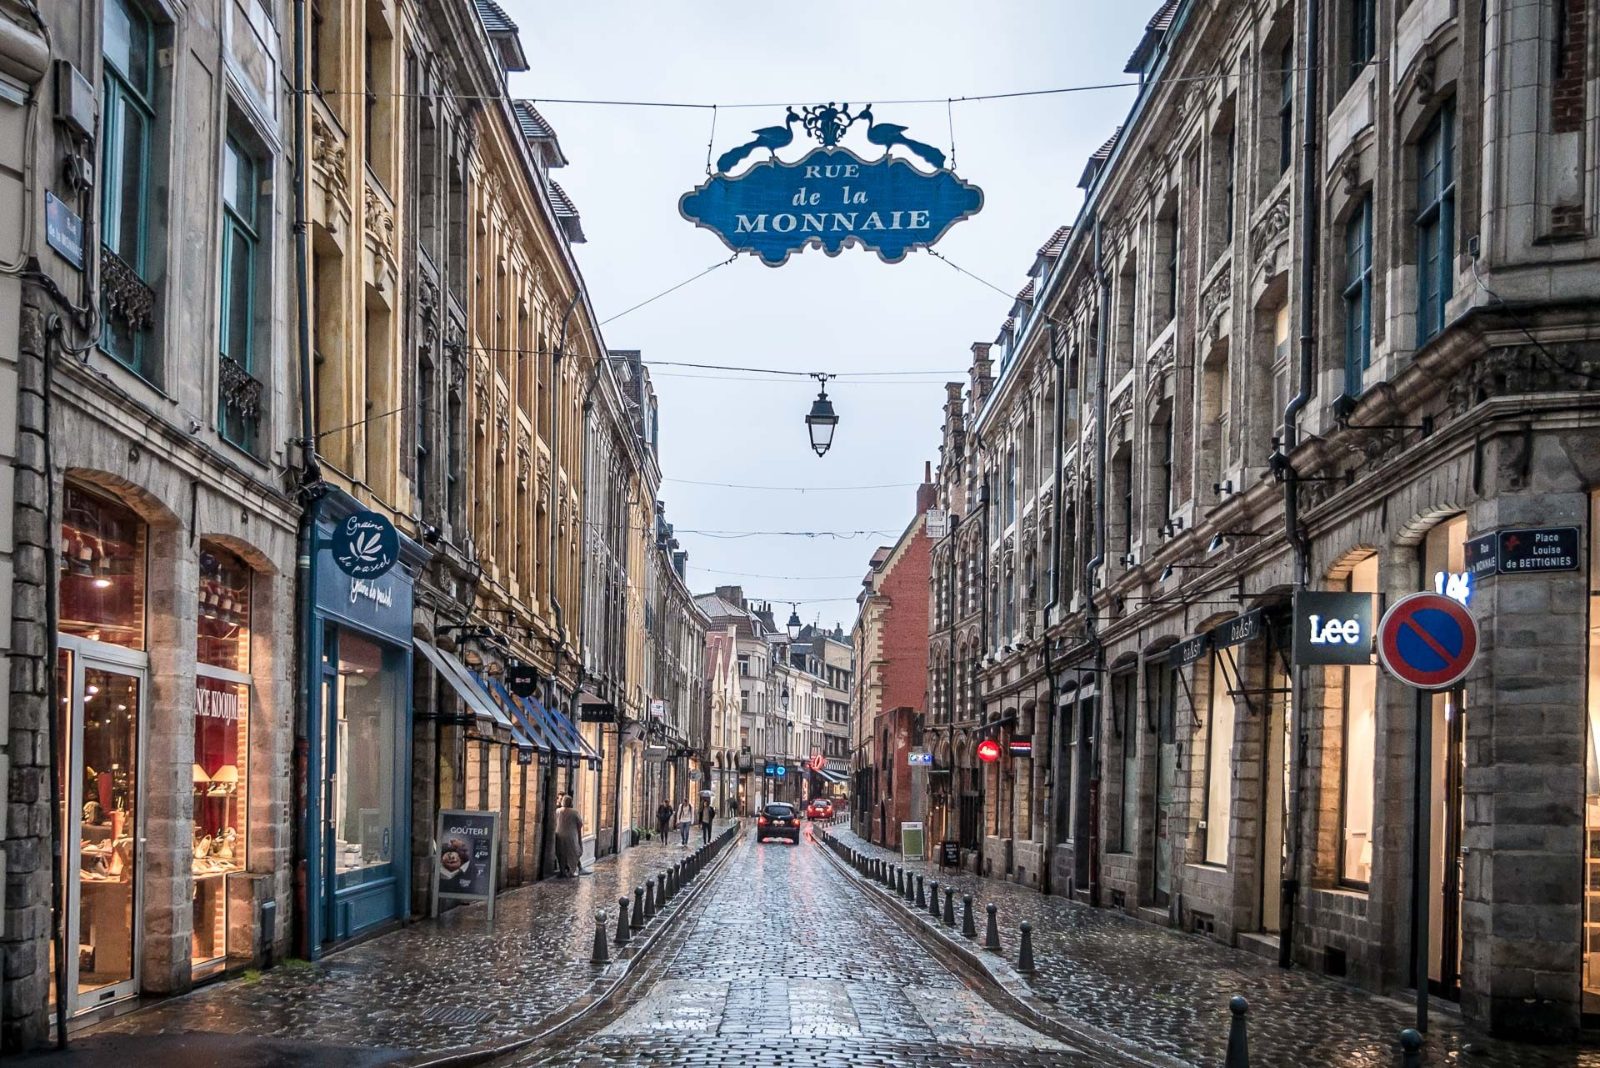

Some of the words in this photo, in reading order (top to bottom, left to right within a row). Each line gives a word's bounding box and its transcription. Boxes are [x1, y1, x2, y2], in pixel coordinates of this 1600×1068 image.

[804, 164, 860, 178] RUE
[792, 188, 821, 206] de
[843, 186, 868, 205] la
[734, 210, 930, 233] MONNAIE
[1535, 533, 1559, 542] Place
[1480, 543, 1489, 554] Rue
[1533, 545, 1561, 555] Louise
[1506, 559, 1517, 568] de
[1519, 556, 1572, 568] BETTIGNIES
[1231, 616, 1254, 641] ba&sh
[1308, 614, 1360, 644] Lee
[1183, 640, 1201, 661] ba&sh
